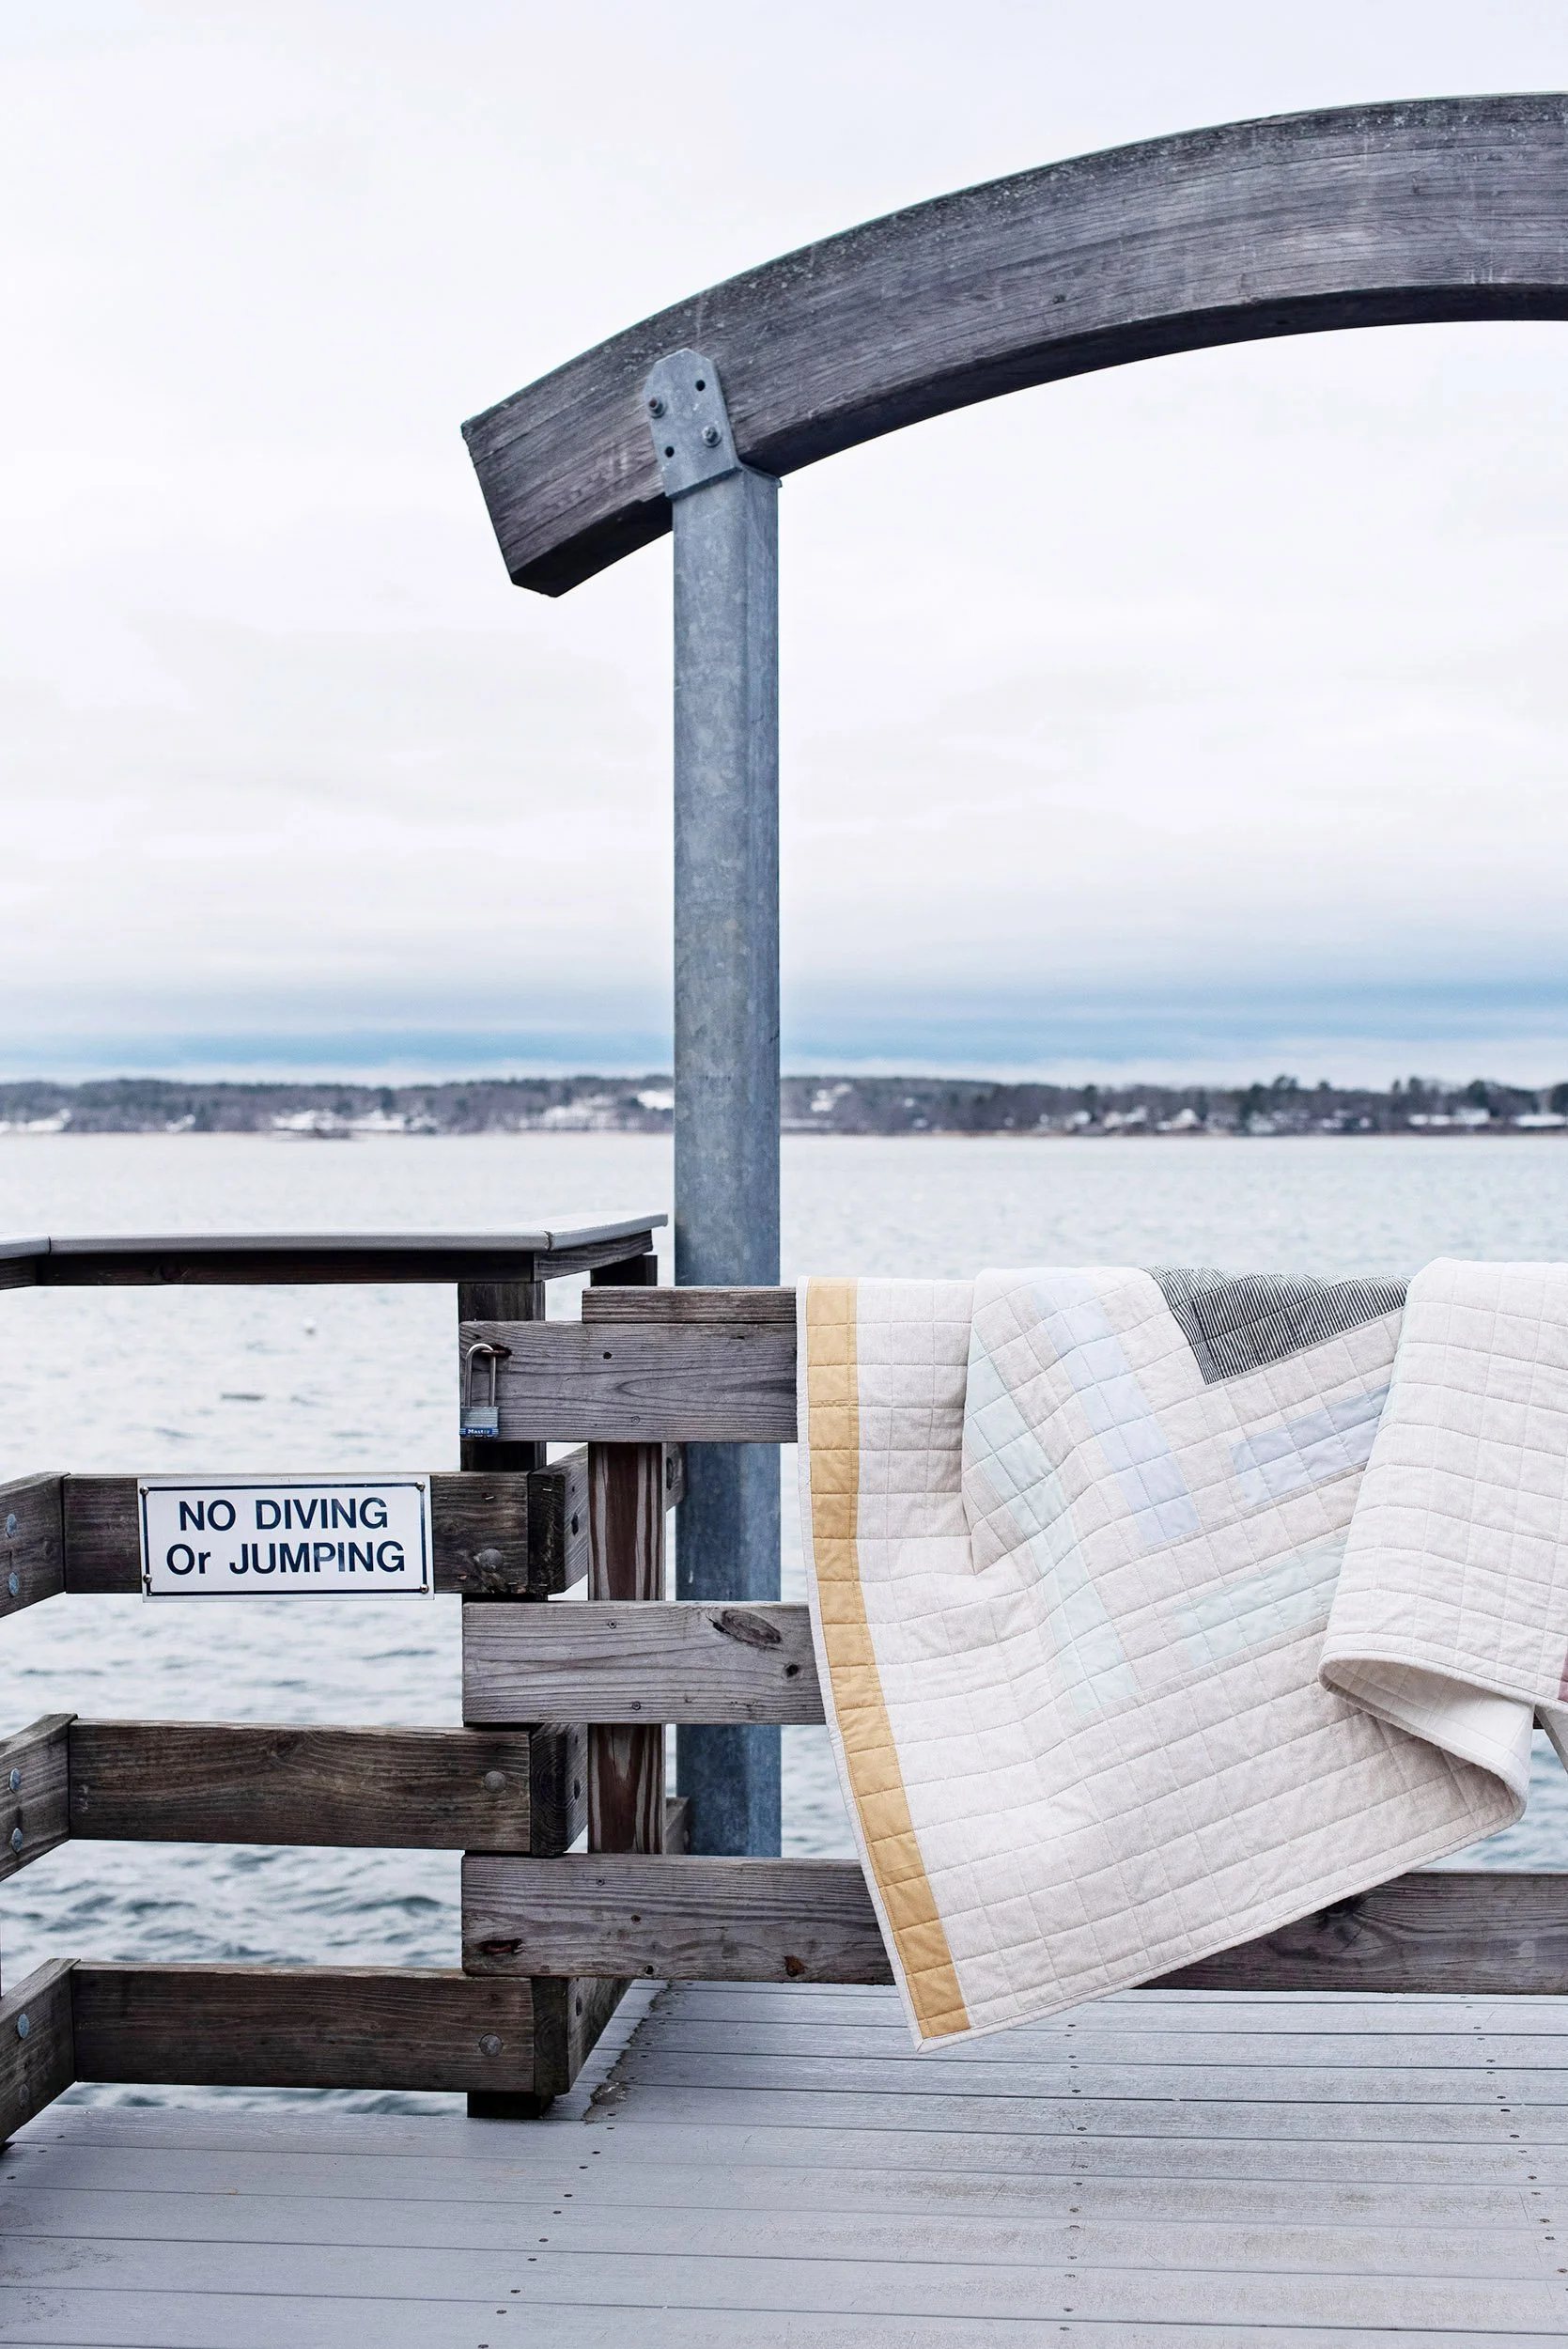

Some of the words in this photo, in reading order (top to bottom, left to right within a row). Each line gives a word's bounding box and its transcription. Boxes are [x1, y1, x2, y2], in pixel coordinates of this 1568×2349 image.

[179, 1500, 235, 1532] NO
[256, 1497, 388, 1530] DIVING
[166, 1543, 211, 1575] Or
[229, 1541, 405, 1574] JUMPING
